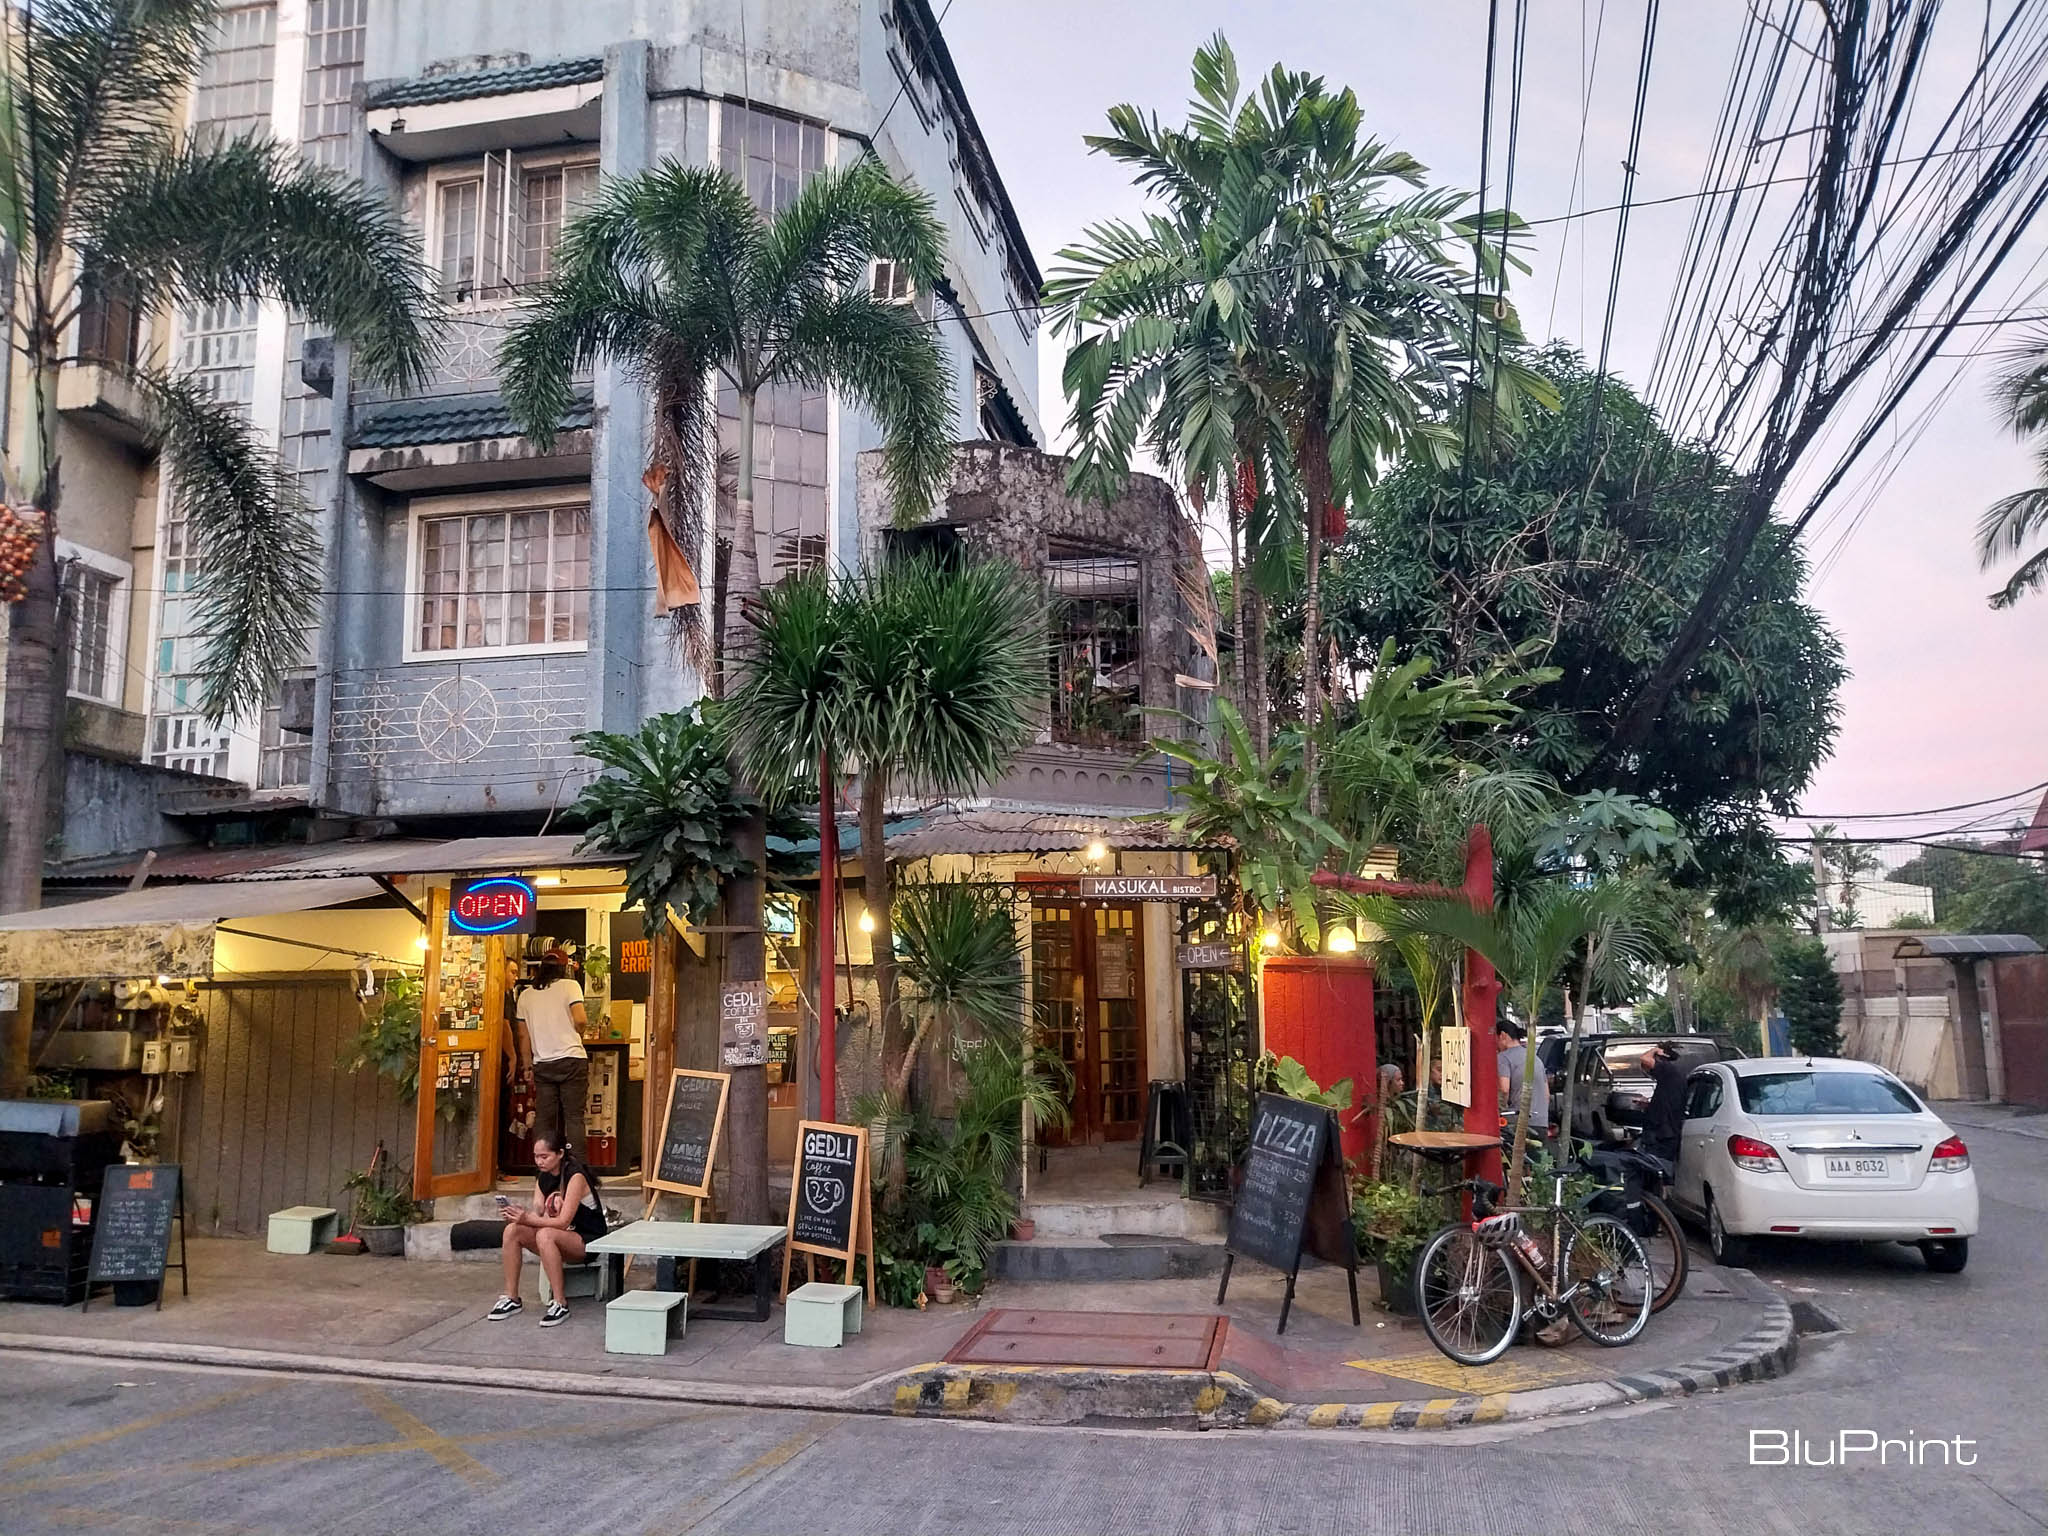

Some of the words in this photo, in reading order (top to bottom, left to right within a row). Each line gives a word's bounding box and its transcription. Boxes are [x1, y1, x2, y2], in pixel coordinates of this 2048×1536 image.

[1094, 879, 1167, 894] MASUKAL
[1172, 886, 1202, 894] BISTRO
[459, 894, 525, 917] OPEN
[621, 940, 649, 957] RIOT
[1187, 946, 1218, 963] OPEN
[723, 992, 762, 1008] GEDLI
[1446, 1040, 1465, 1067] TACOS
[1254, 1112, 1317, 1158] PIZZA
[805, 1133, 852, 1159] GEDLI
[805, 1161, 832, 1176] Coffee
[1830, 1160, 1851, 1172] AAA
[1855, 1160, 1885, 1172] 8032
